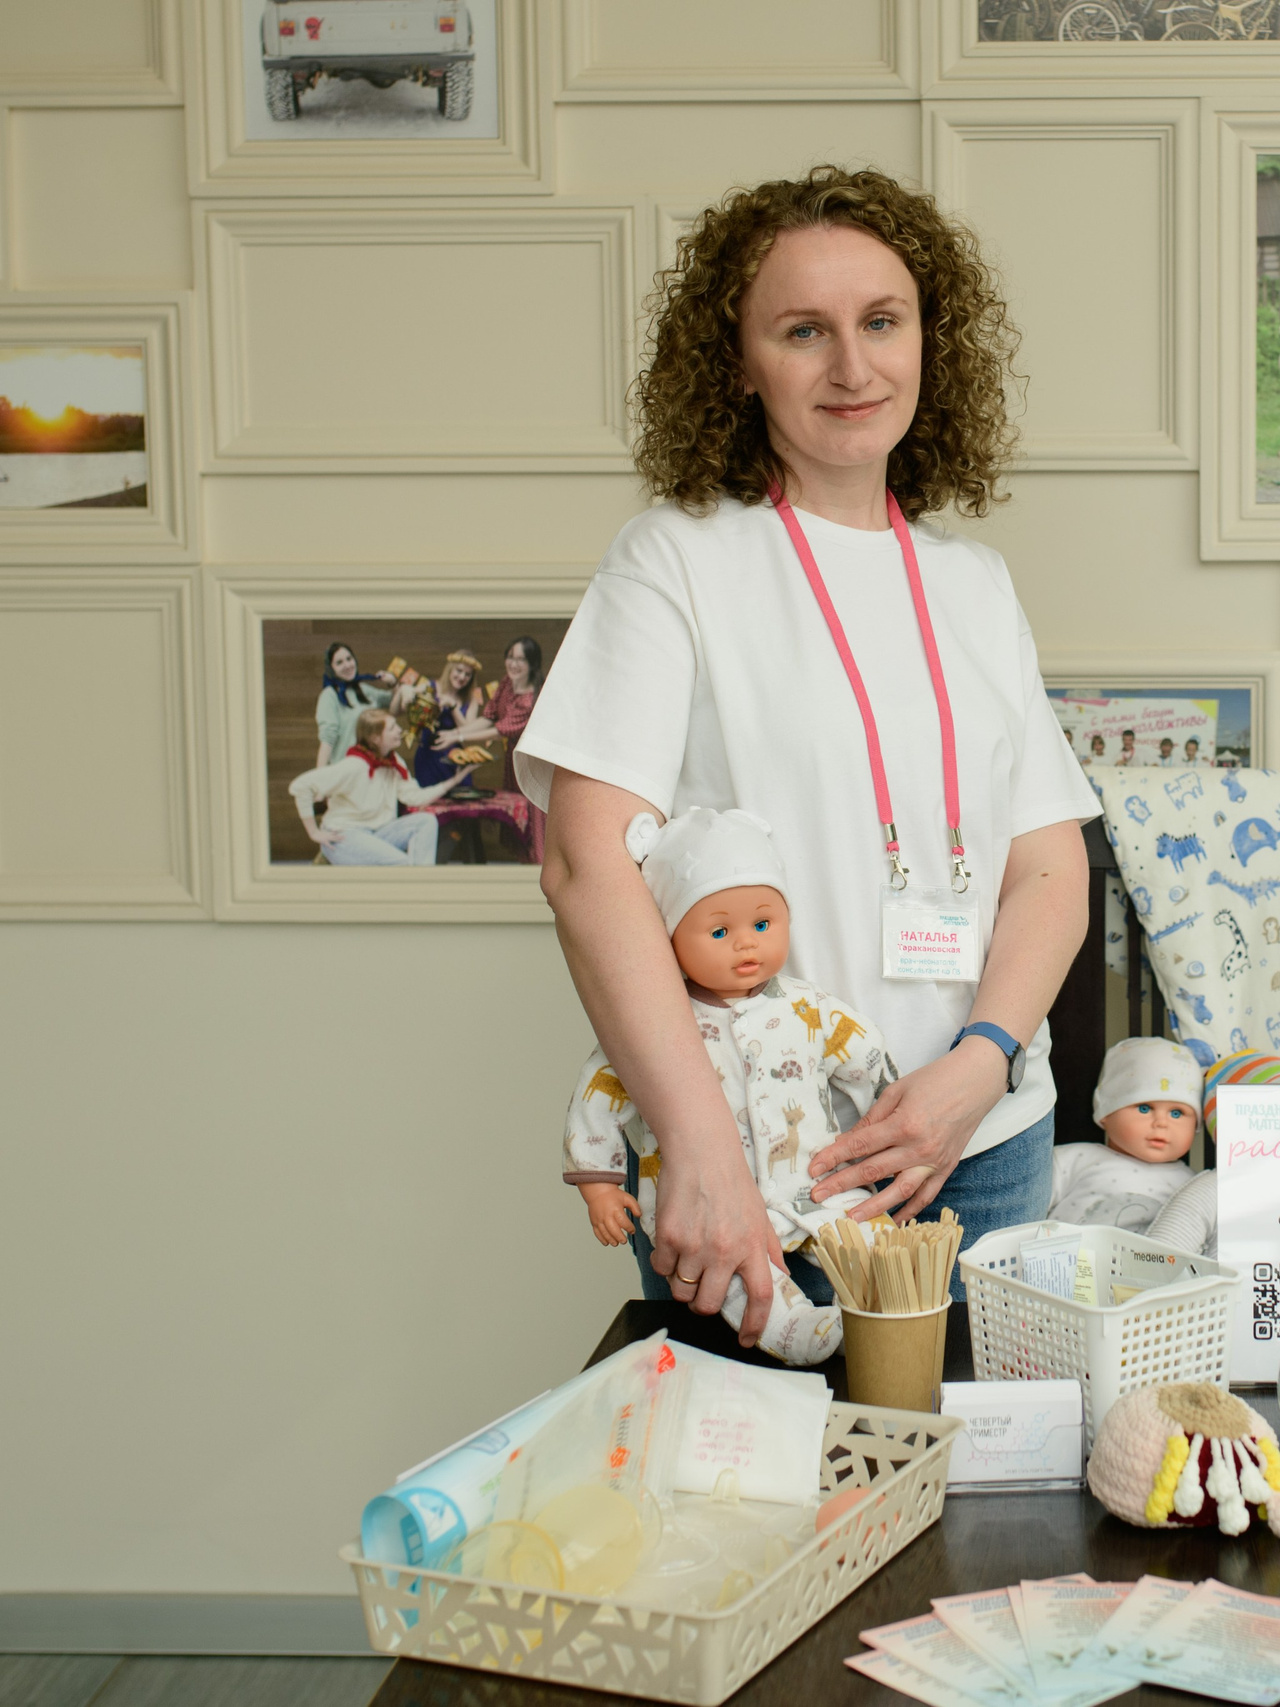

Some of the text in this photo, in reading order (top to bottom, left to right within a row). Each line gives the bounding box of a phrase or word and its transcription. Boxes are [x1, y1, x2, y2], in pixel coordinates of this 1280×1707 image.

[900, 930, 958, 943] НАТАЛЬЯ
[897, 943, 961, 954] Таракановская
[1133, 1252, 1165, 1264] medela
[969, 1415, 1012, 1428] ЧЕТВЕРТЫЙ
[969, 1427, 1008, 1438] ТРИМЕСТР
